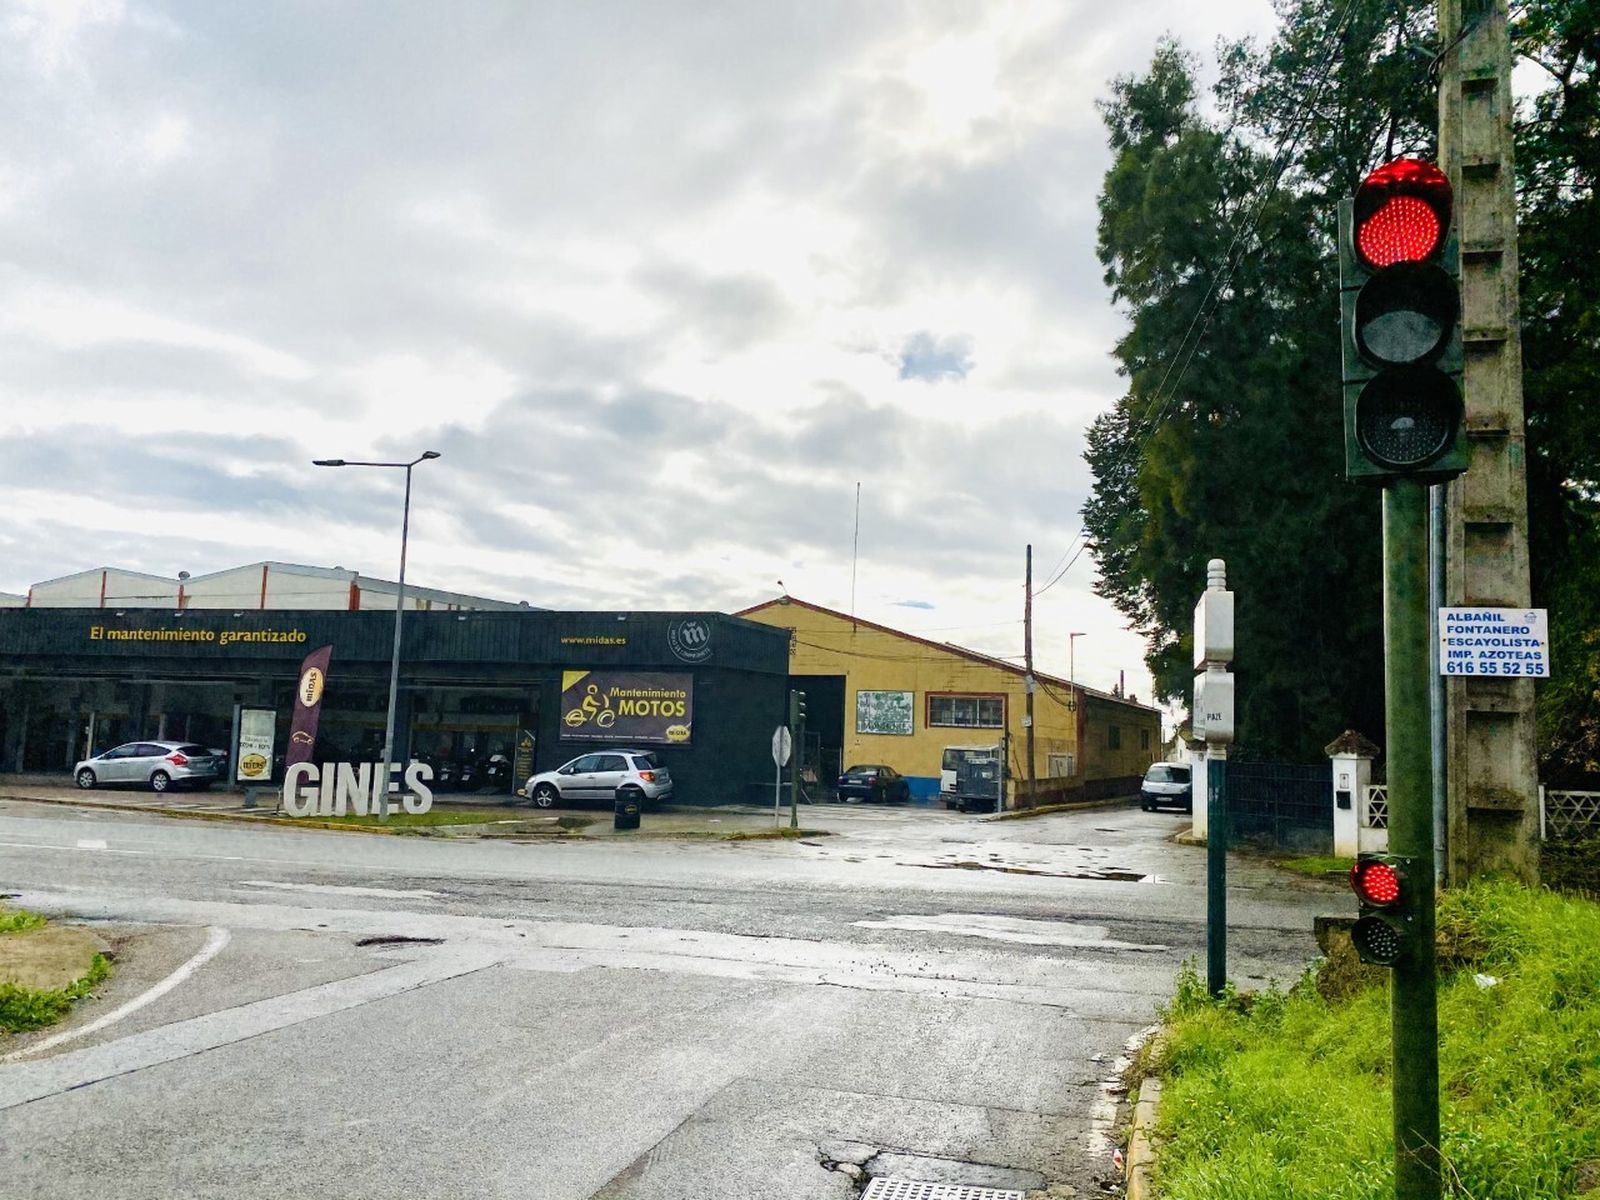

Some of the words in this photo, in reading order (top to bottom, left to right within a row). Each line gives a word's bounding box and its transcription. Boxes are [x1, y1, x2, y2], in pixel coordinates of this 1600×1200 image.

[1447, 611, 1505, 622] ALBAÑIL
[89, 626, 104, 640] El
[107, 627, 215, 642] mantenimiento
[219, 628, 306, 645] garantizado
[1447, 625, 1531, 635] FONTANERO
[560, 635, 627, 646] www.midas.es
[1447, 637, 1541, 648] ESCAYOLISTA
[1448, 650, 1475, 659] IMP.
[1479, 650, 1542, 660] AZOTEAS
[1447, 661, 1475, 674] 616
[1479, 662, 1498, 674] 55
[1502, 662, 1521, 675] 52
[1525, 662, 1544, 675] 55
[610, 686, 687, 699] Mantenimiento
[618, 700, 686, 718] MOTOS
[283, 761, 434, 818] GINES
